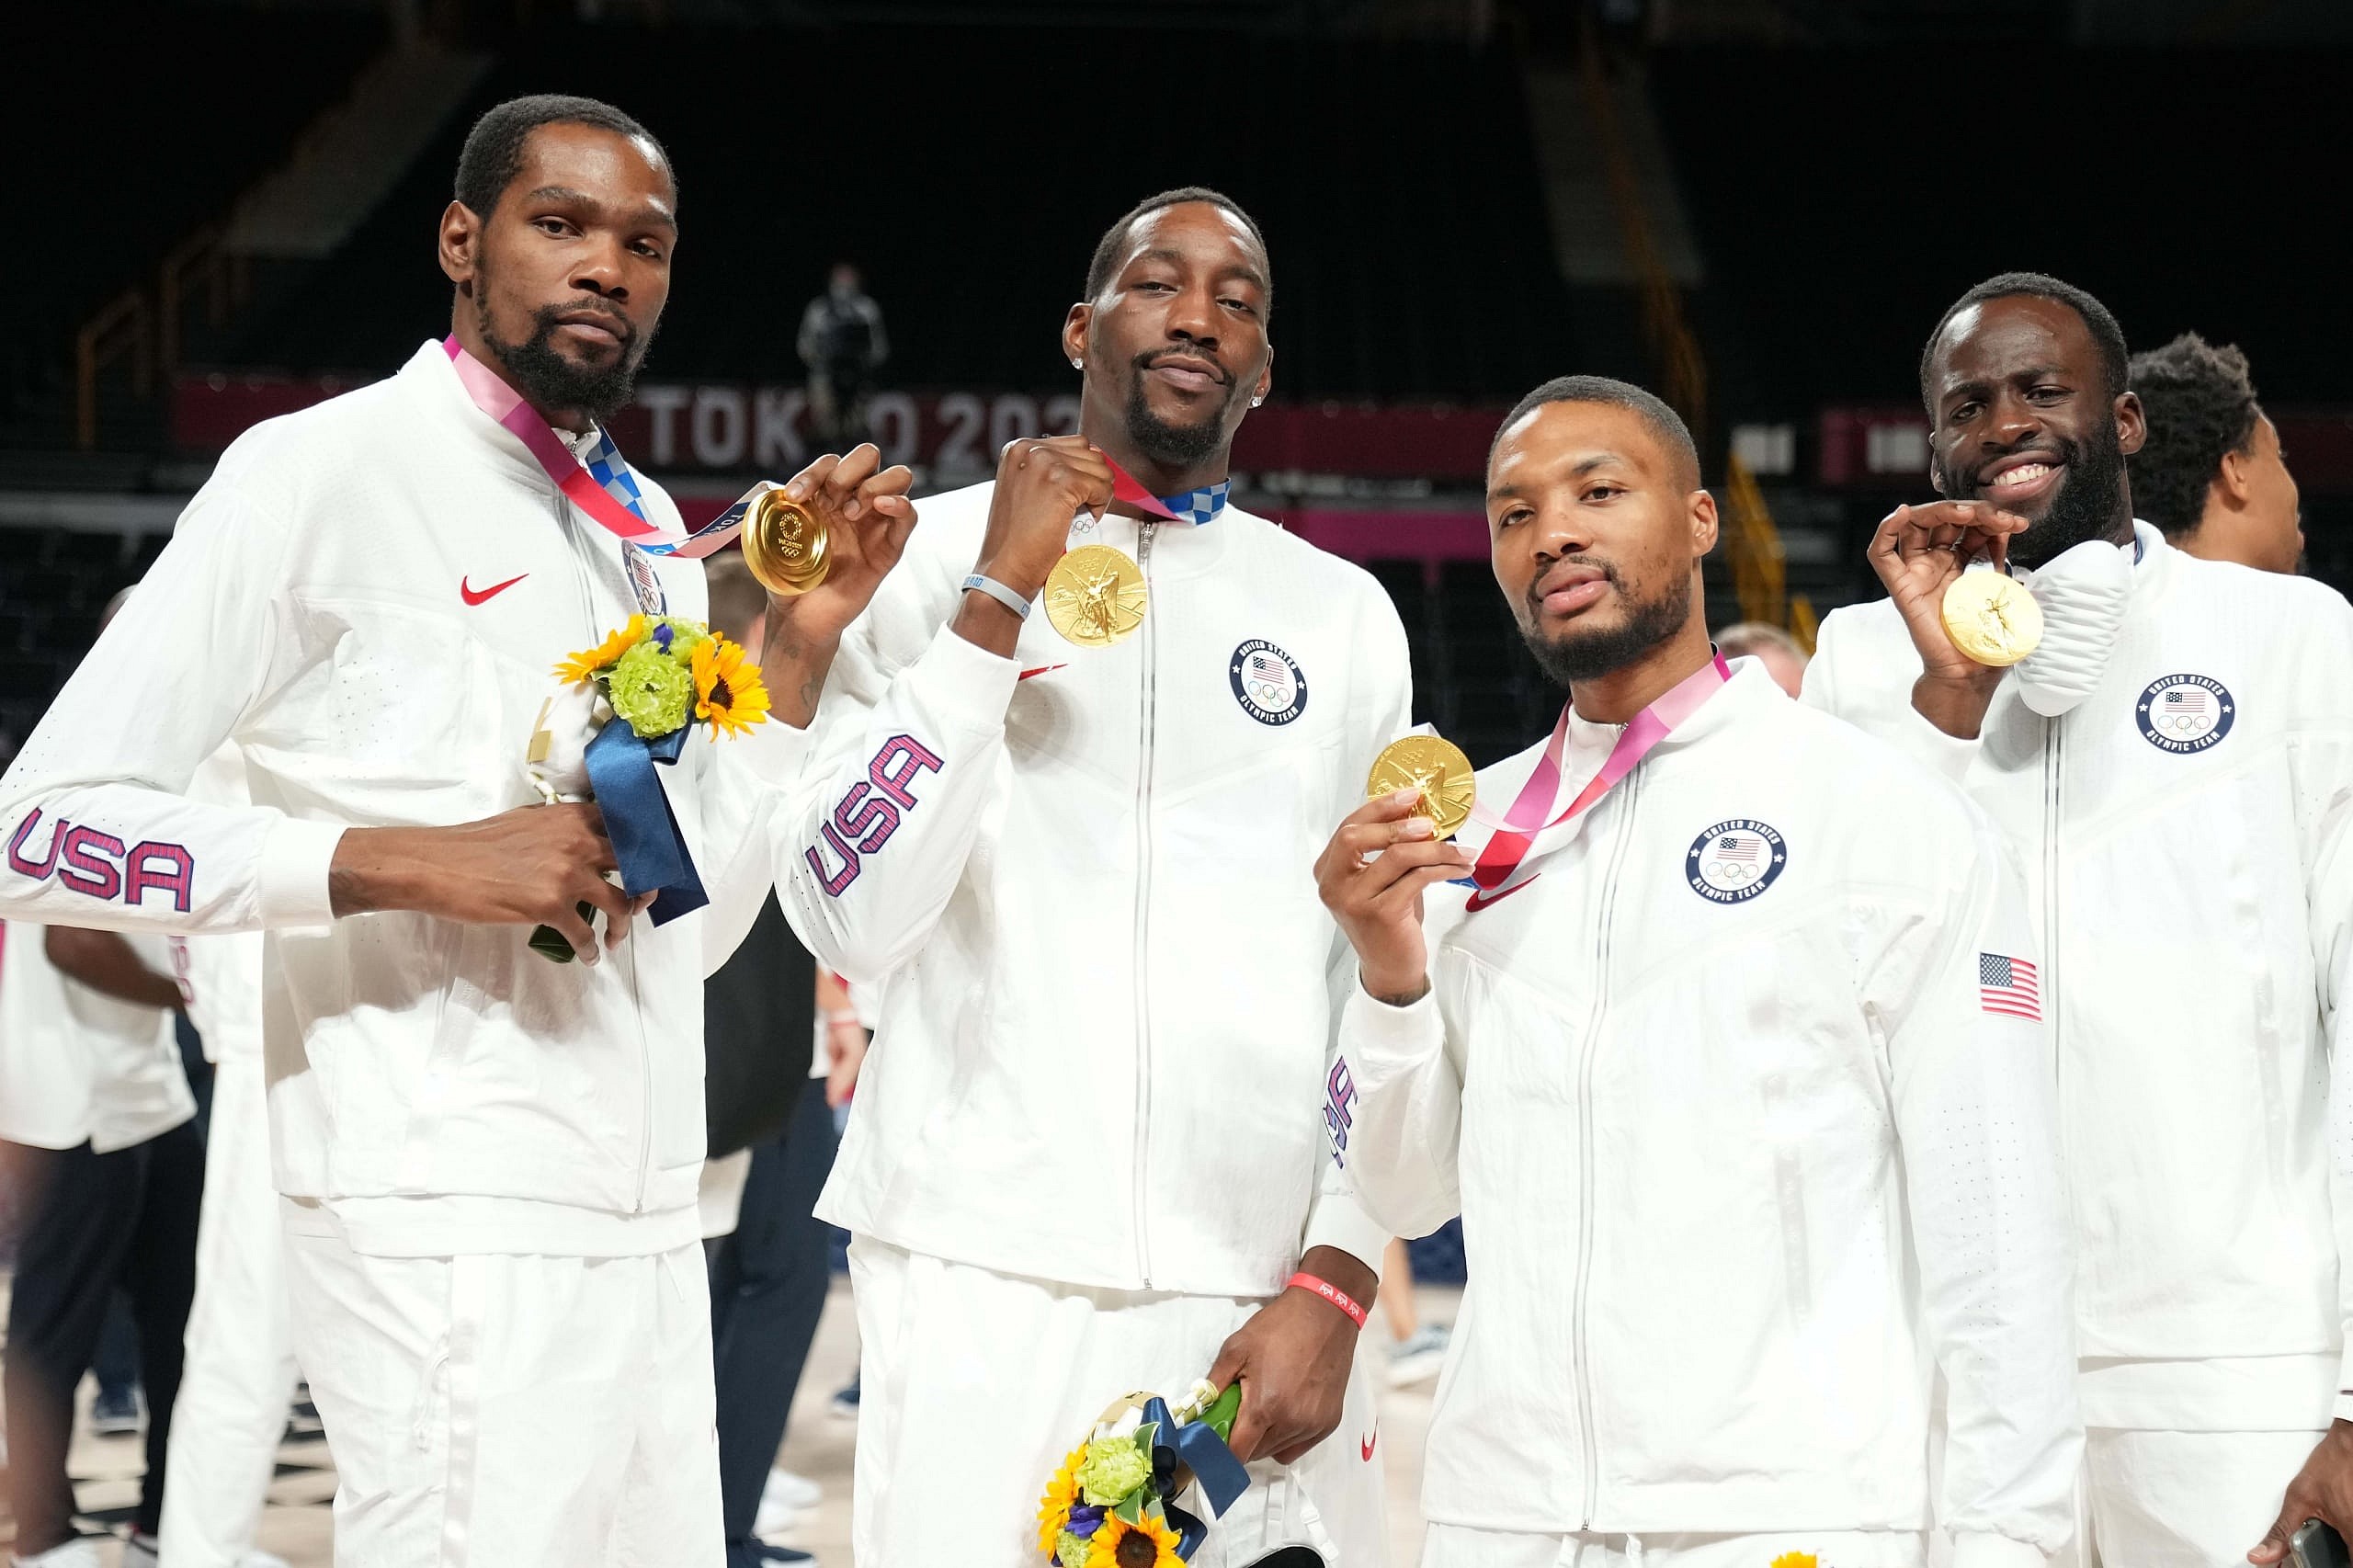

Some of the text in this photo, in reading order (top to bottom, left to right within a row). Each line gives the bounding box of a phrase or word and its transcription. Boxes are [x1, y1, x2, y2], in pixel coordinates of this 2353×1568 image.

[640, 386, 1082, 468] TOKO 202
[1238, 641, 1298, 670] UNITED STATES
[2148, 675, 2225, 696] UNITED STATES
[1240, 695, 1299, 722] OLYMPIC TEAM
[2146, 729, 2221, 752] OLYMPIC TEAM
[805, 733, 945, 898] USA
[1703, 820, 1781, 845] UNITED STATES
[7, 807, 195, 913] USA
[1691, 877, 1766, 901] OLYMPIC TEAM
